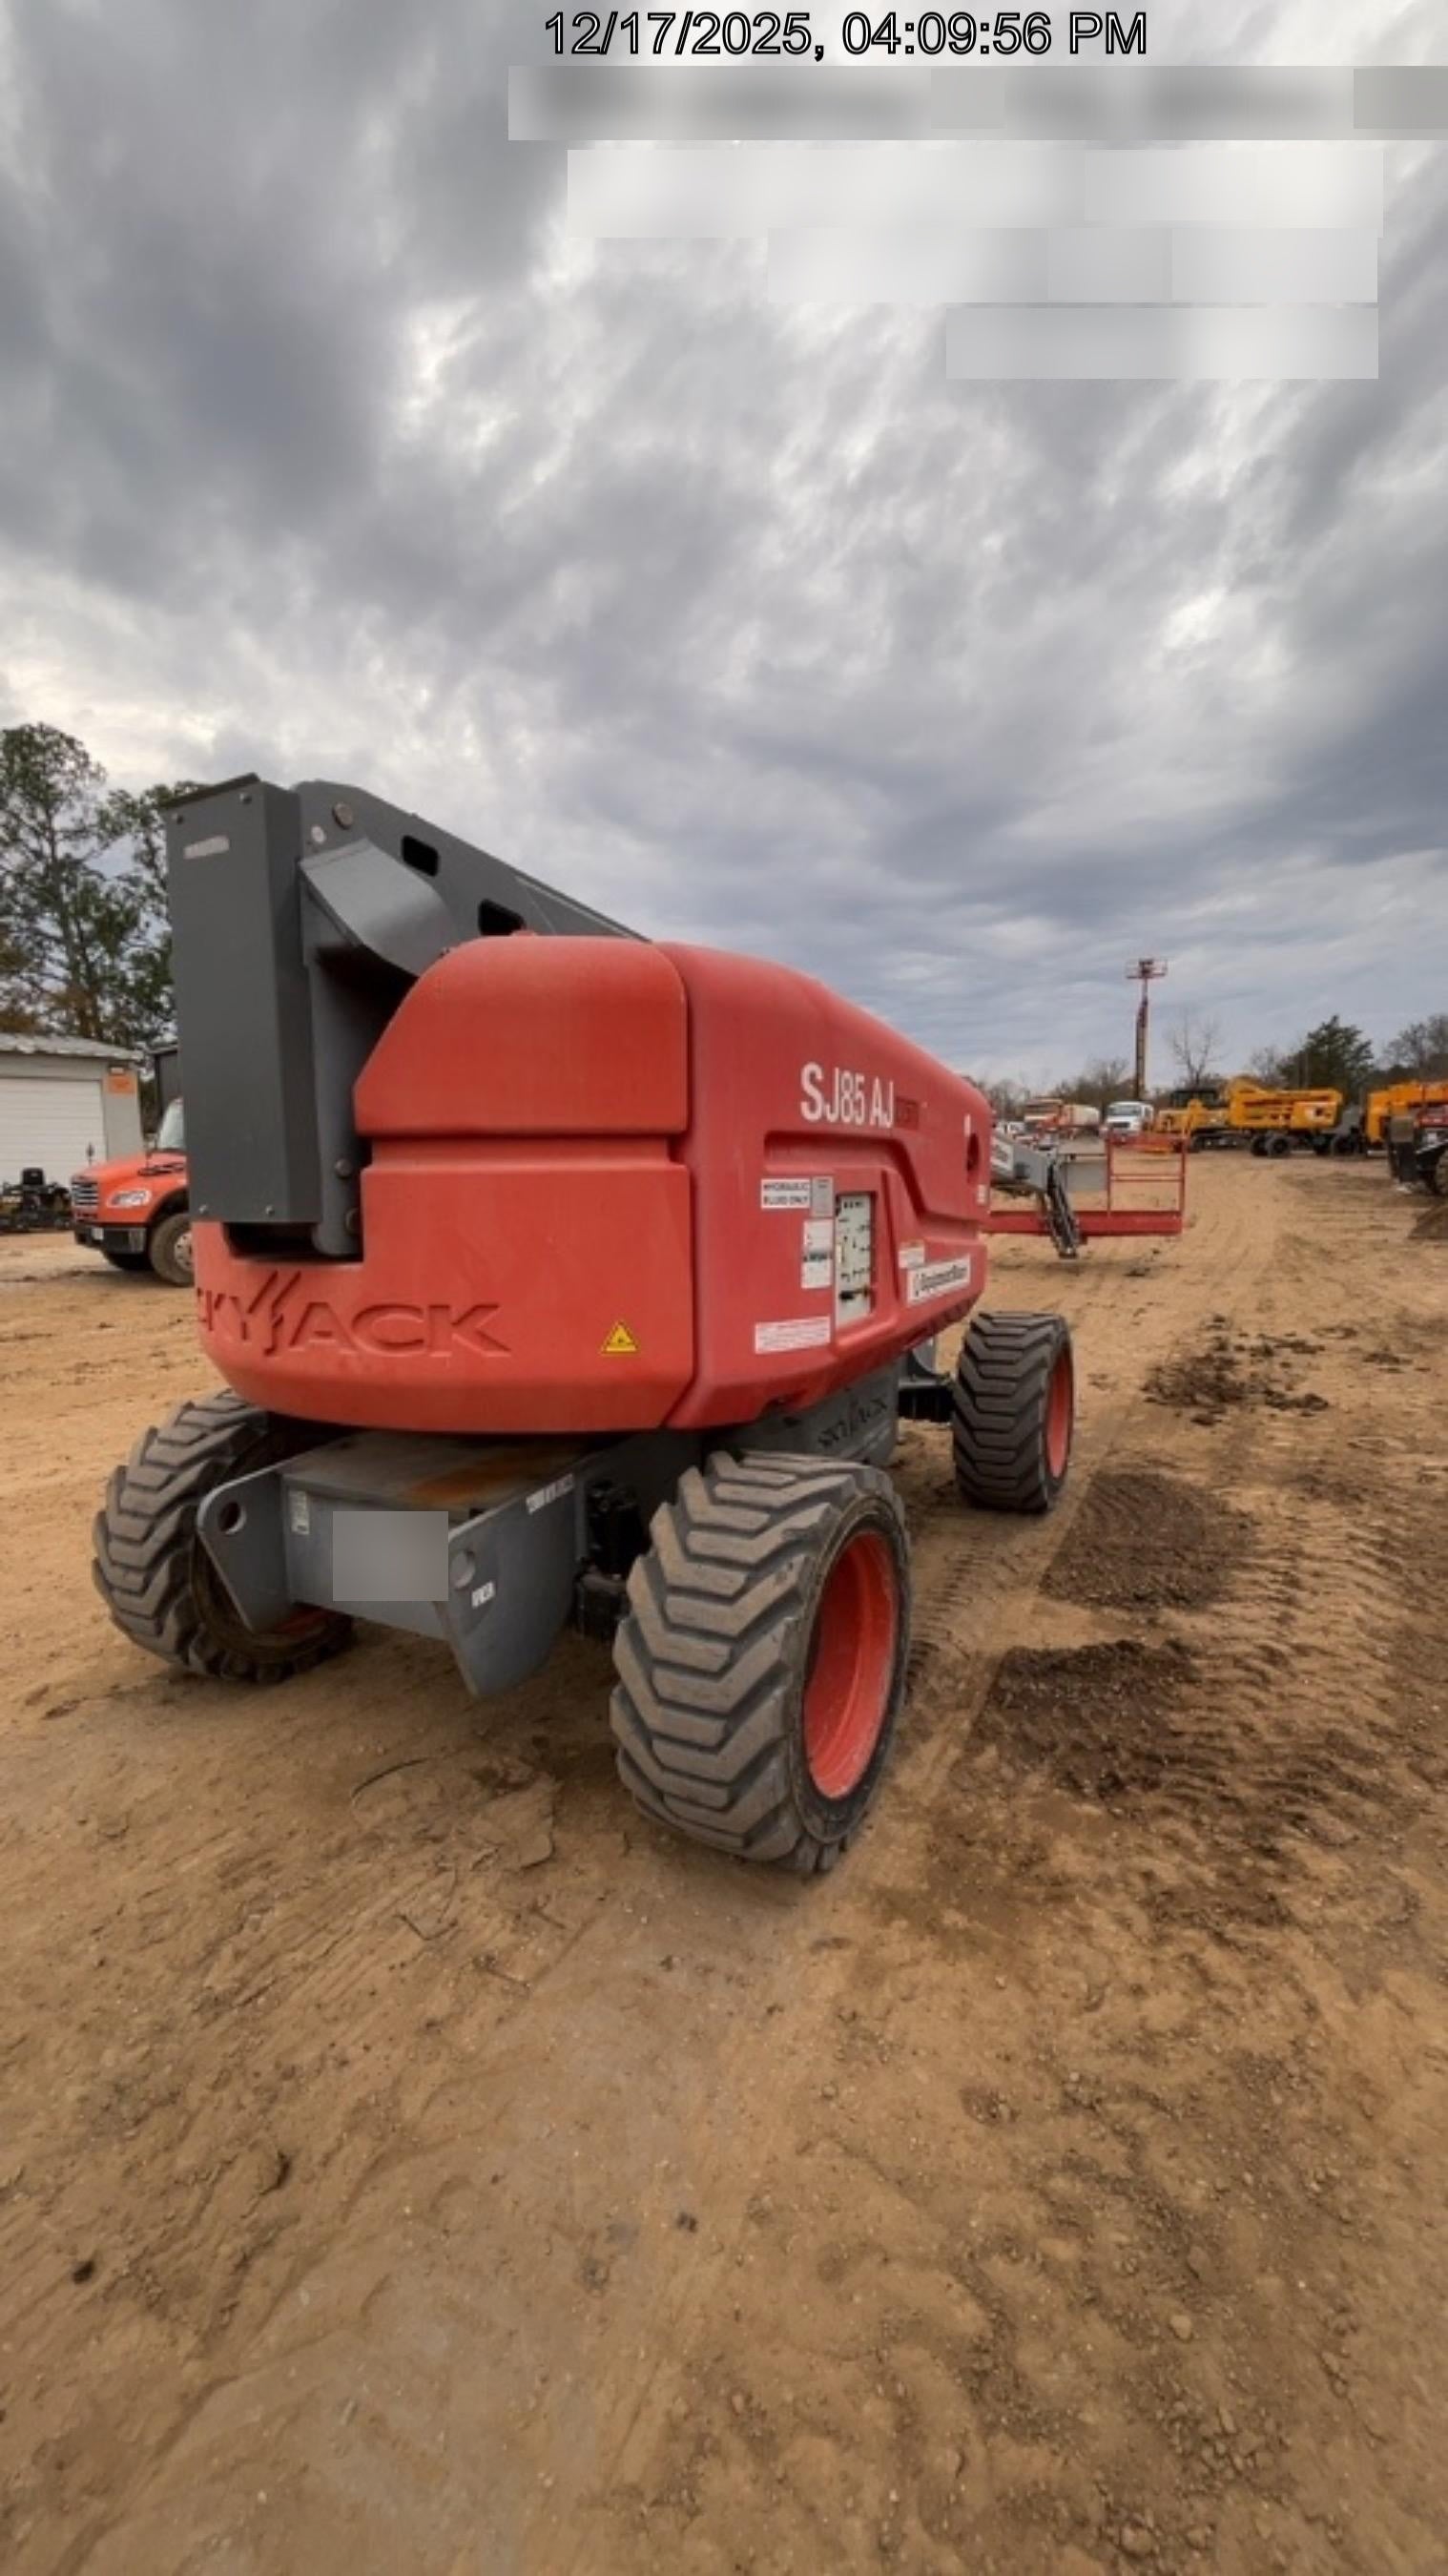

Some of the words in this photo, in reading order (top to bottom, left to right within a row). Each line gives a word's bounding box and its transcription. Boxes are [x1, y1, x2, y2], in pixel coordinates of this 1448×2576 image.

[800, 1061, 865, 1126] SJ85
[869, 1076, 894, 1129] AJ
[196, 1270, 512, 1358] KYJACK
